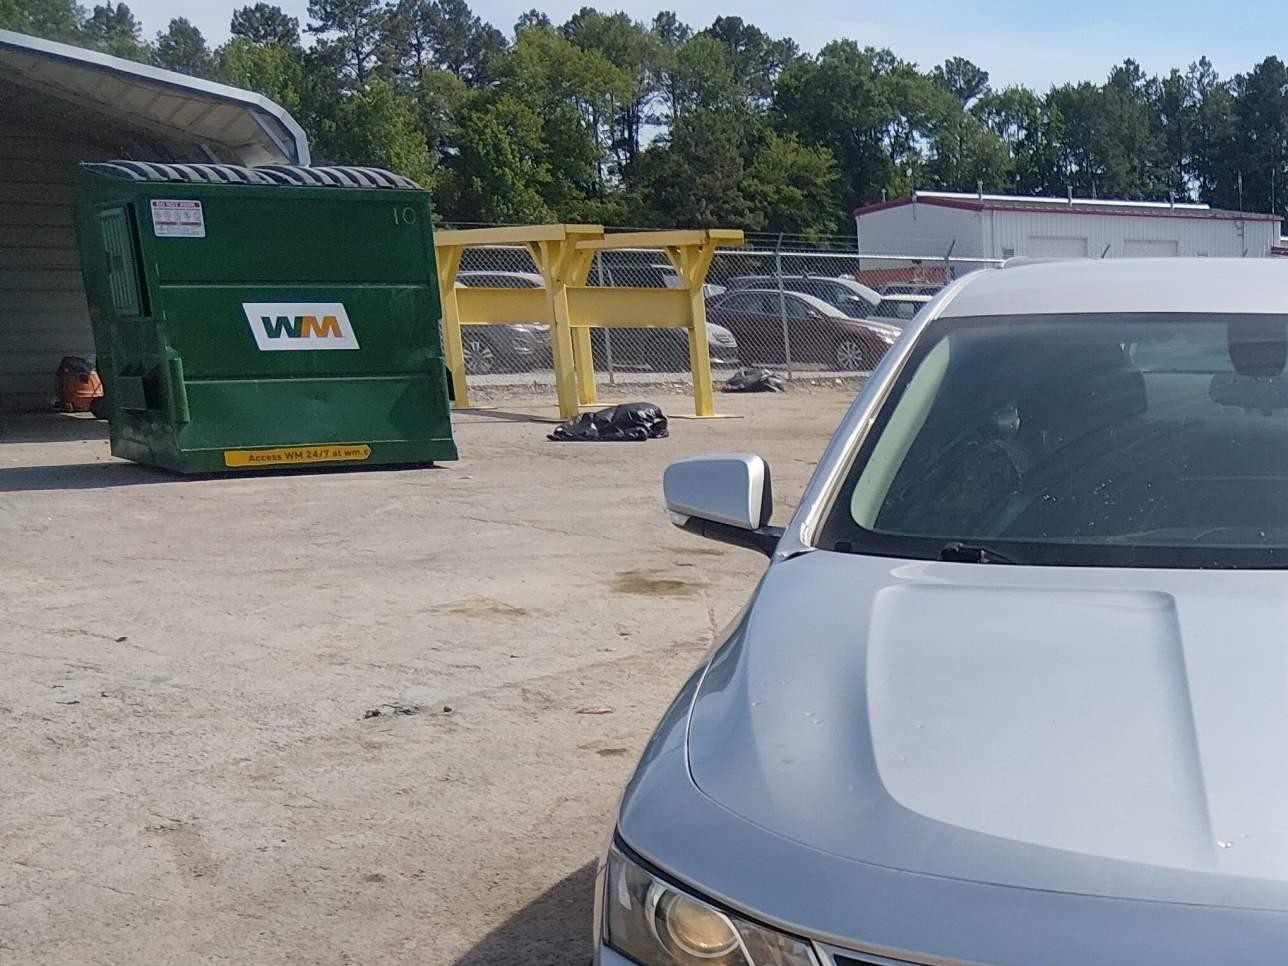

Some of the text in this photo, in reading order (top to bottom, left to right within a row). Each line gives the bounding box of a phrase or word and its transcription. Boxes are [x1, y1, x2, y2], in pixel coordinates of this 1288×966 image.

[261, 316, 343, 338] WM
[248, 453, 282, 462] Access
[285, 452, 303, 460] WM
[306, 450, 329, 459] 24/7
[333, 449, 342, 457] at
